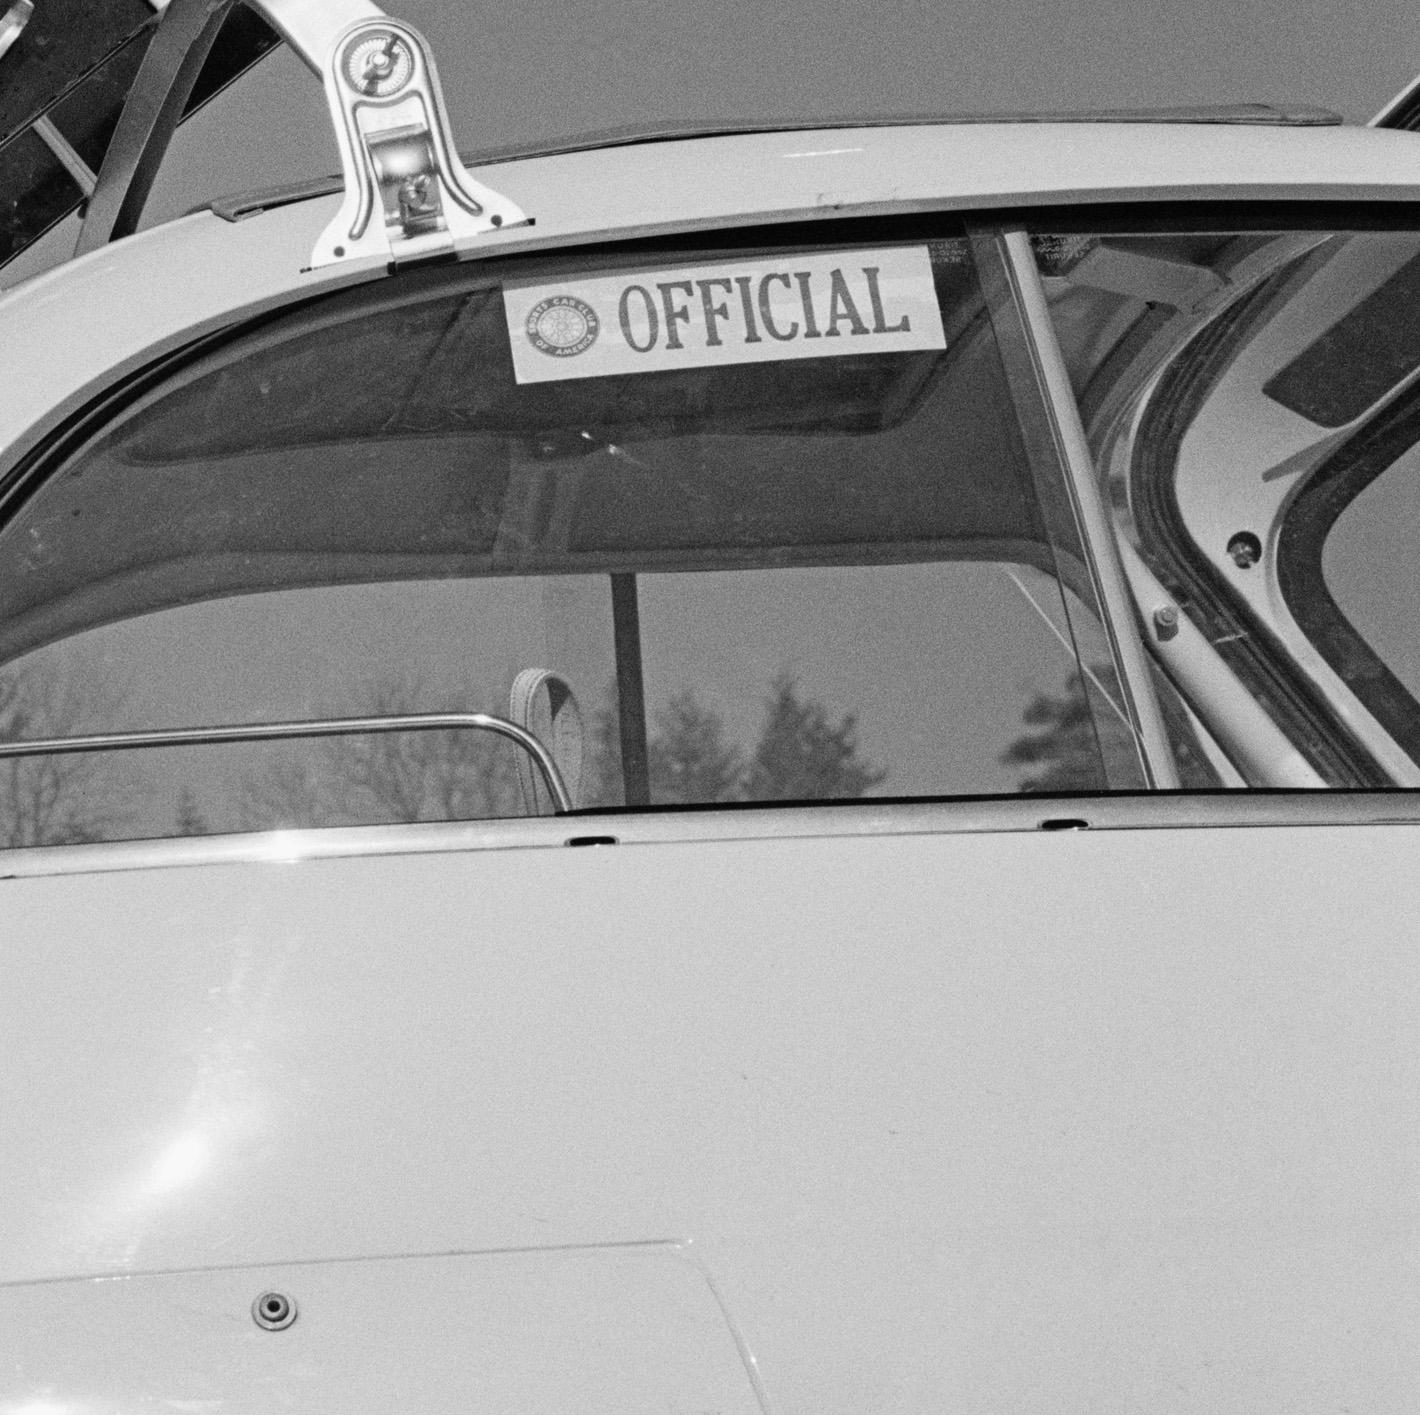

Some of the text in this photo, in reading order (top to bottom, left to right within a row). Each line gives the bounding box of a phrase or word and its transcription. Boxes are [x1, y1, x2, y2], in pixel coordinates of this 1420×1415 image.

[552, 297, 576, 307] CAR
[578, 303, 597, 328] CLUB
[618, 267, 911, 353] OFFICIAL
[535, 333, 595, 356] OF AMERICA
